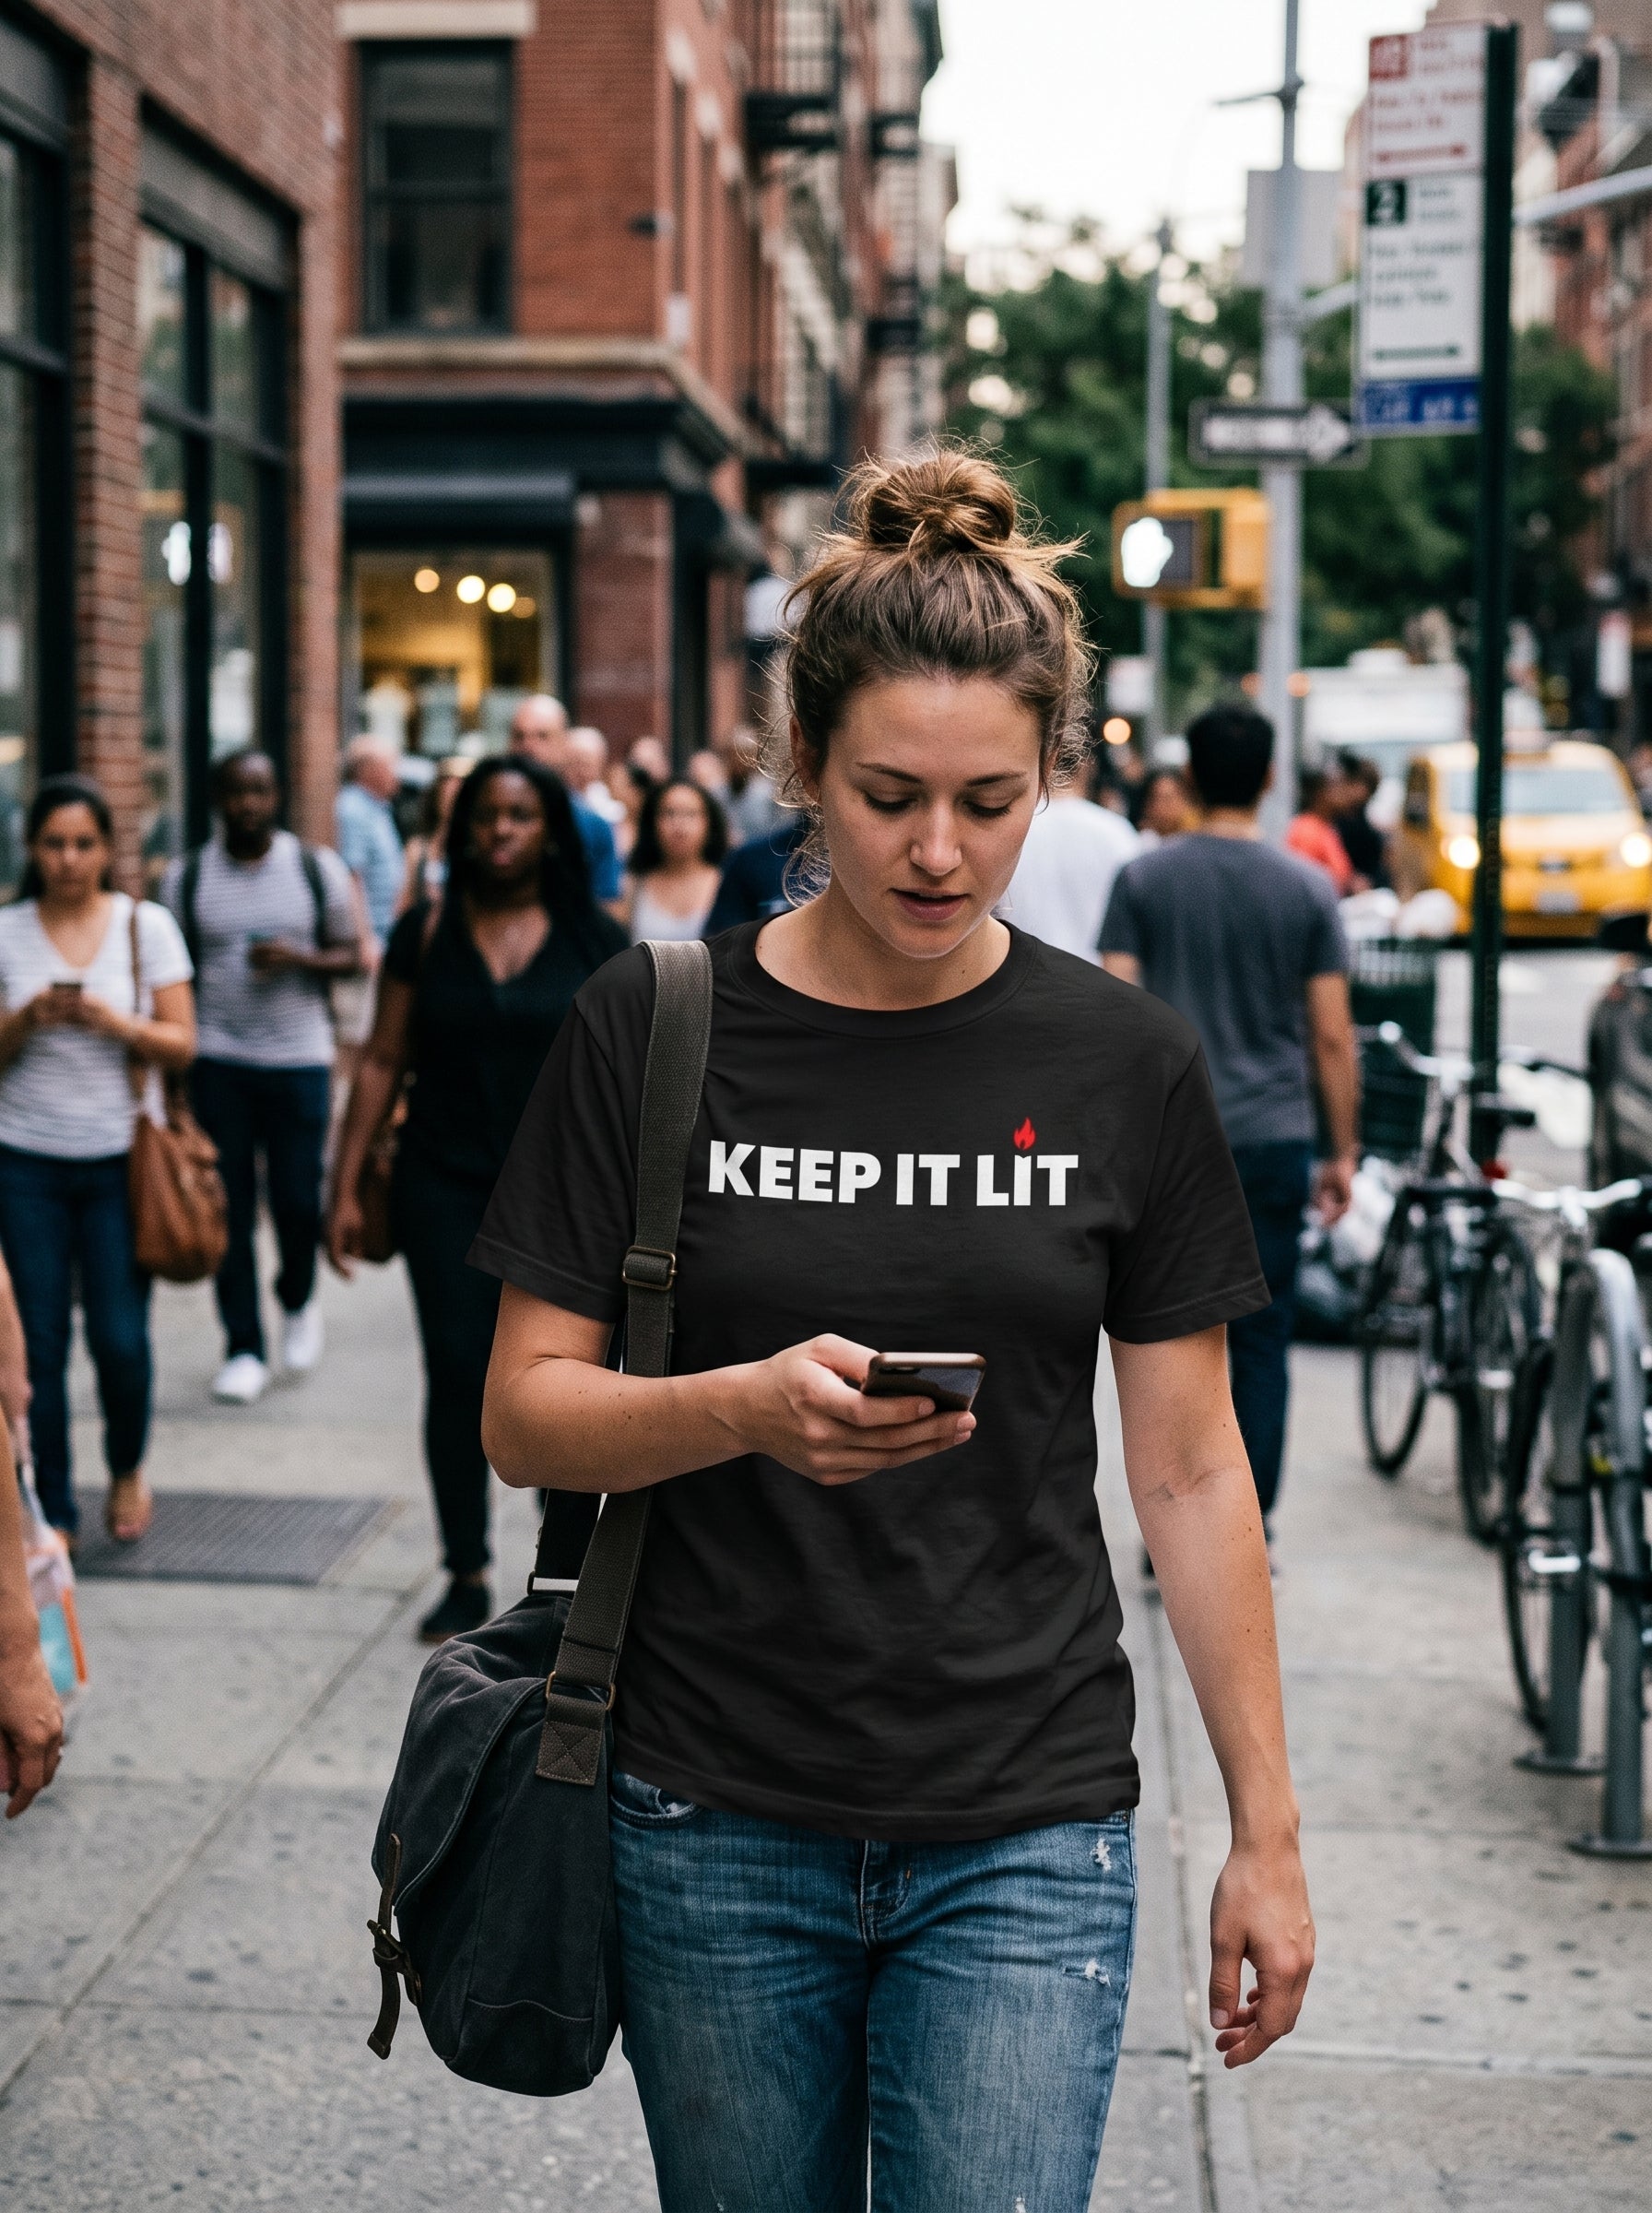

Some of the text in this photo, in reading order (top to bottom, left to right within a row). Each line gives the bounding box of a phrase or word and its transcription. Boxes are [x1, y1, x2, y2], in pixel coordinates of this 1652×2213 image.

[708, 1140, 1080, 1207] KEEP IT LIT
